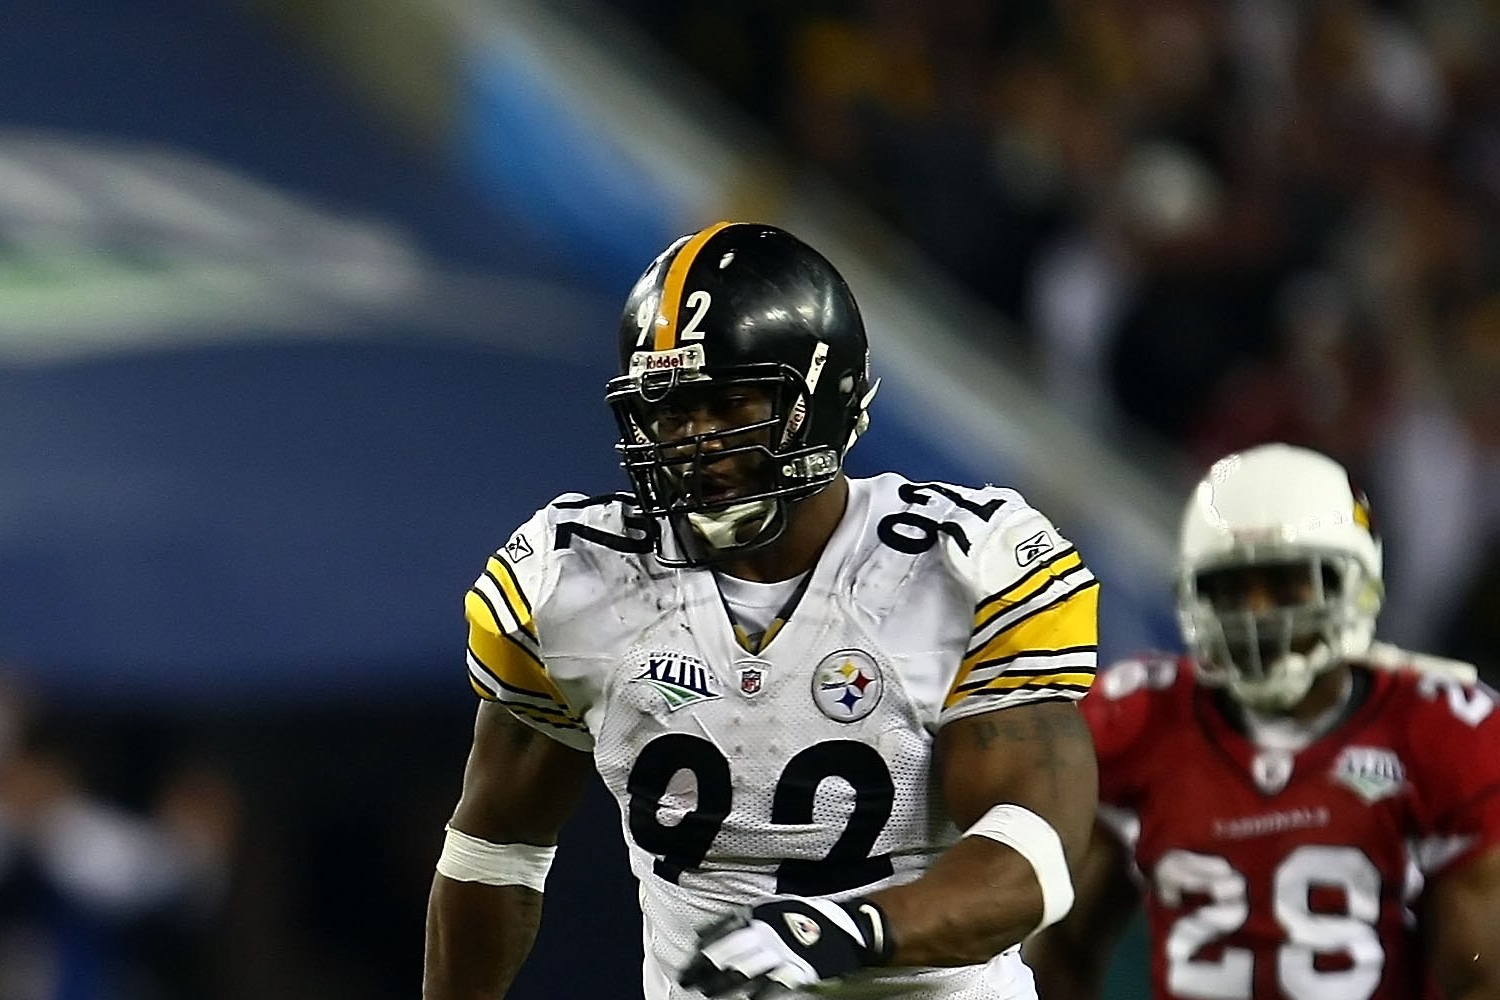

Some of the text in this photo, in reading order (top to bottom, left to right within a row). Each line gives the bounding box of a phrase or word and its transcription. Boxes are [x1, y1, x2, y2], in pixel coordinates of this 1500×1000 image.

[877, 483, 1007, 557] 92
[639, 659, 711, 696] XLIII
[626, 732, 895, 898] 92
